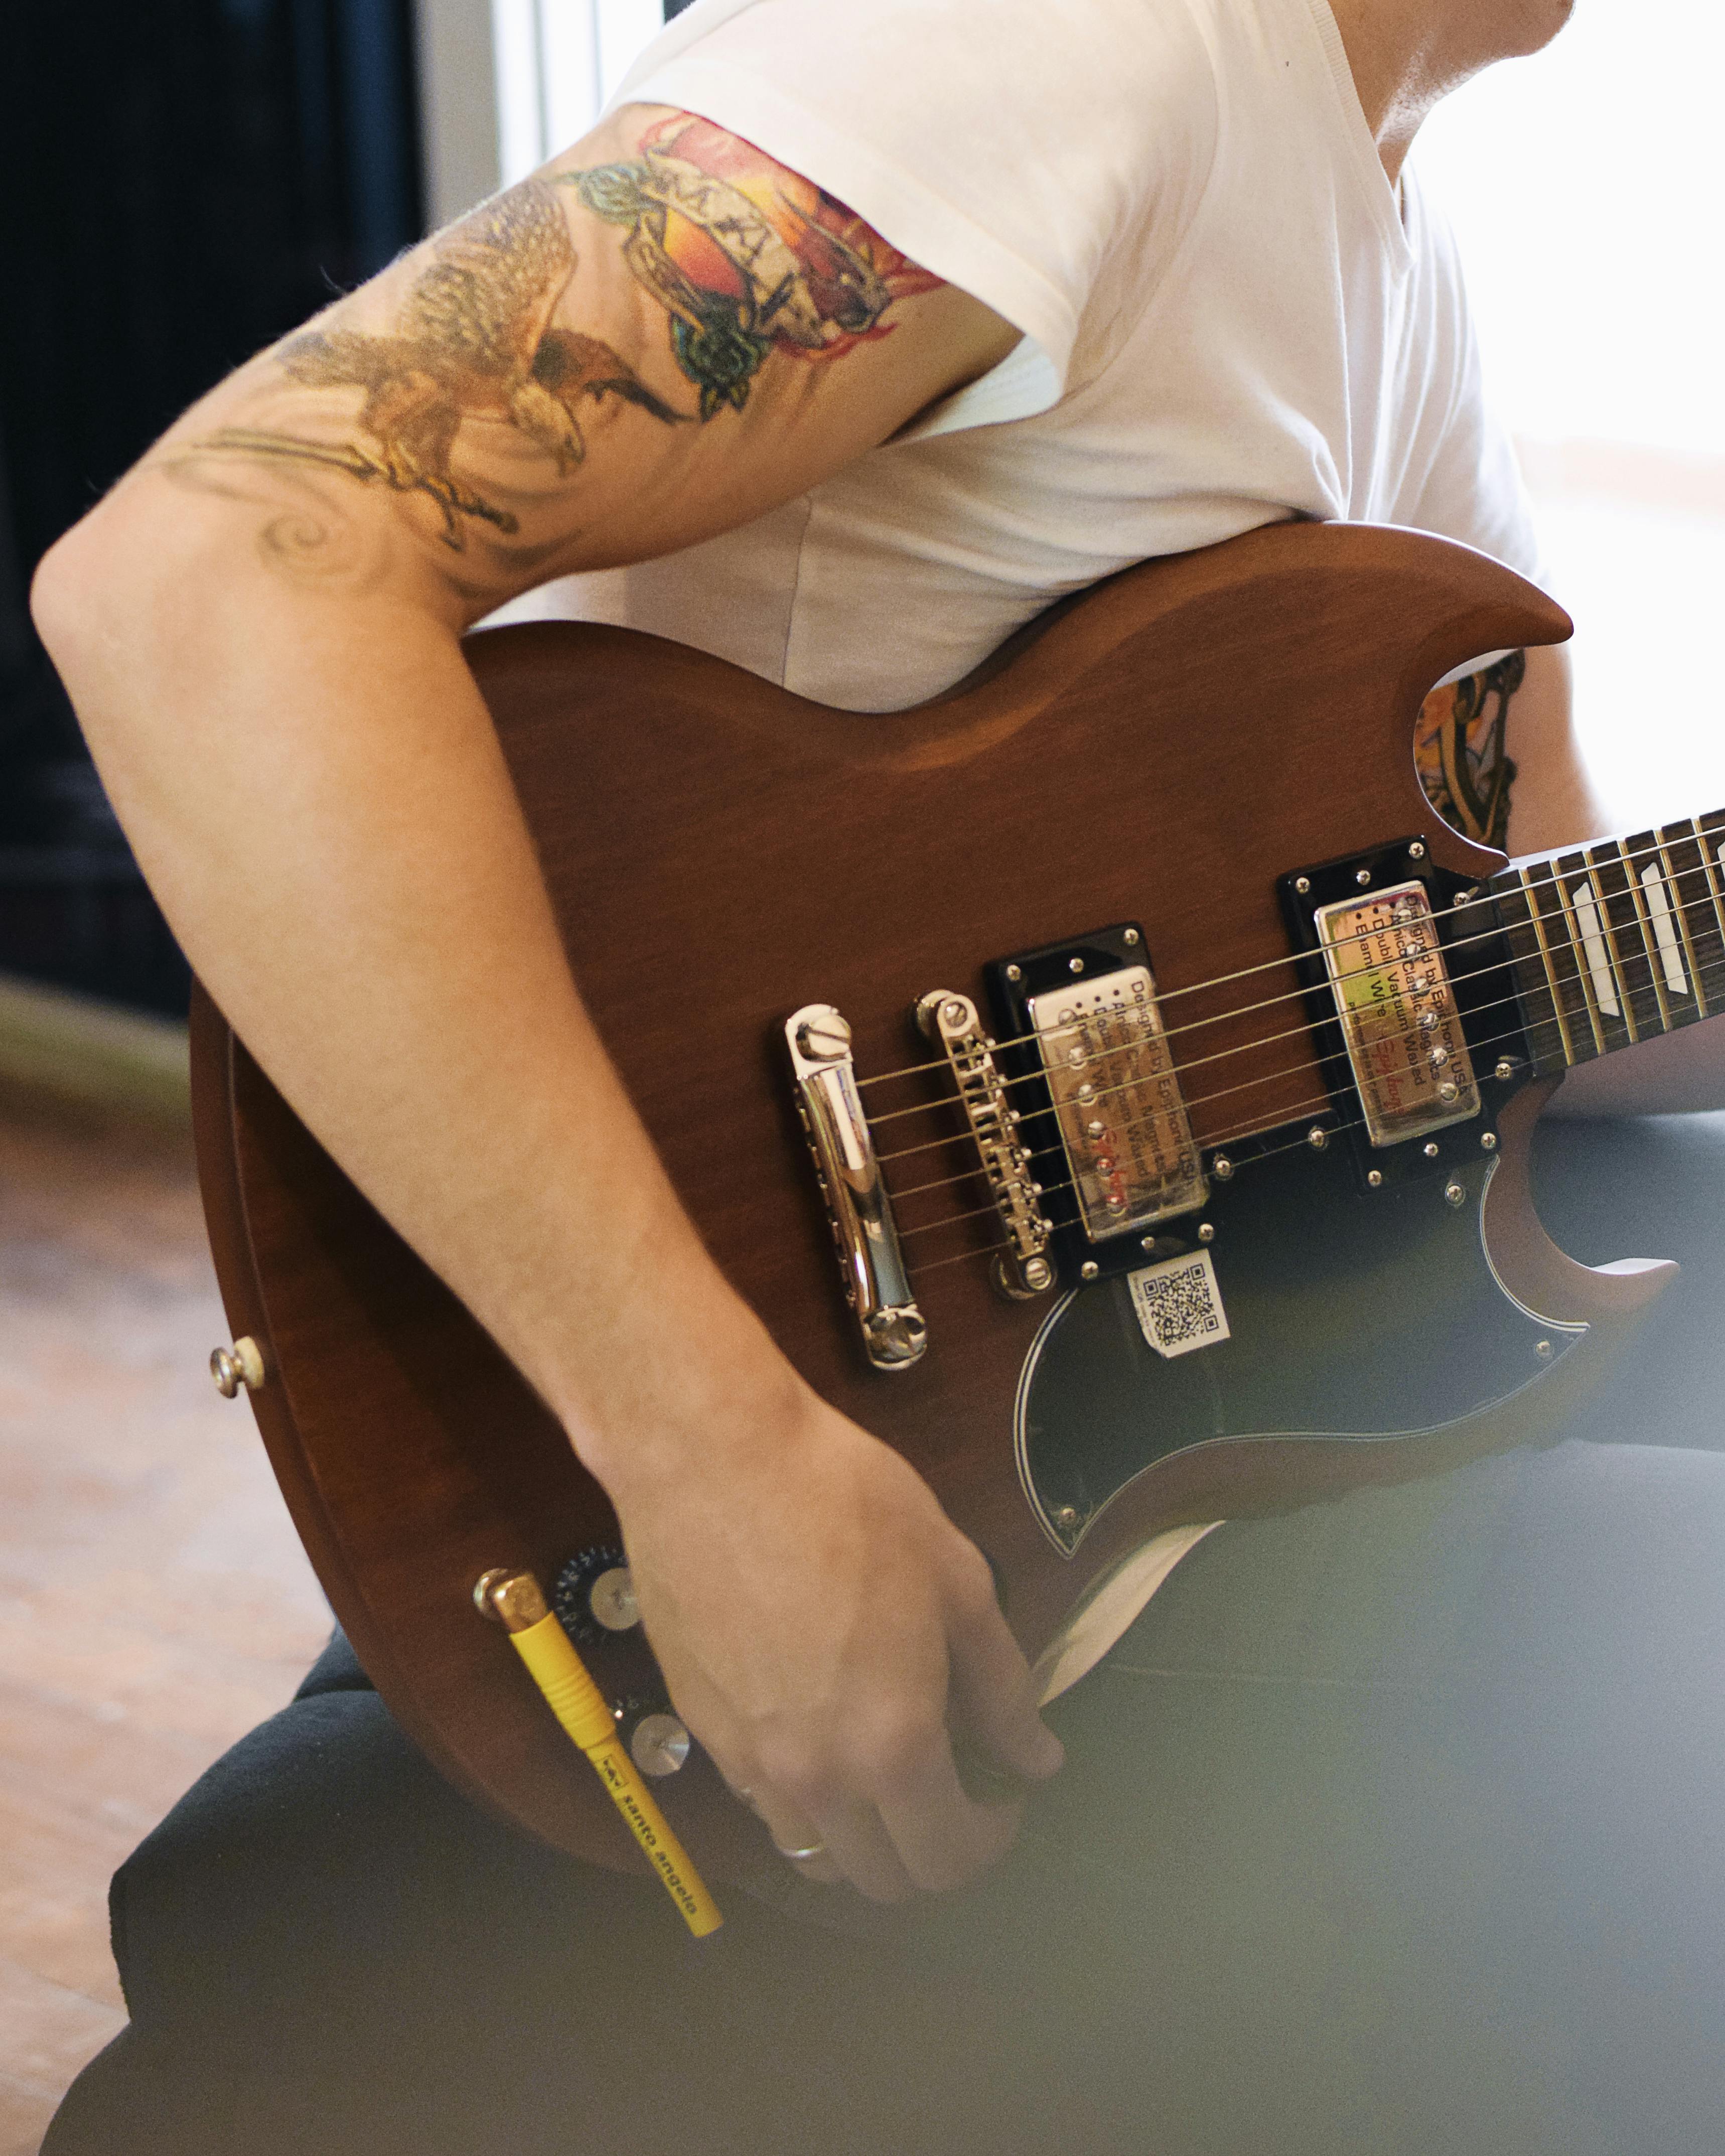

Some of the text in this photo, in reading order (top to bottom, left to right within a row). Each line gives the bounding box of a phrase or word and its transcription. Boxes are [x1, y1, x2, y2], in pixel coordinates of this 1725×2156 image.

[1355, 923, 1379, 977] Eaml
[1388, 912, 1411, 958] Anico
[1093, 1007, 1117, 1056] Doubl
[1131, 980, 1160, 1052] Designed
[1372, 918, 1426, 1086] Doubl Vacuum Waxed
[1424, 967, 1440, 987] by
[1450, 1061, 1470, 1096] USA
[623, 1794, 698, 1914] santo angelo
